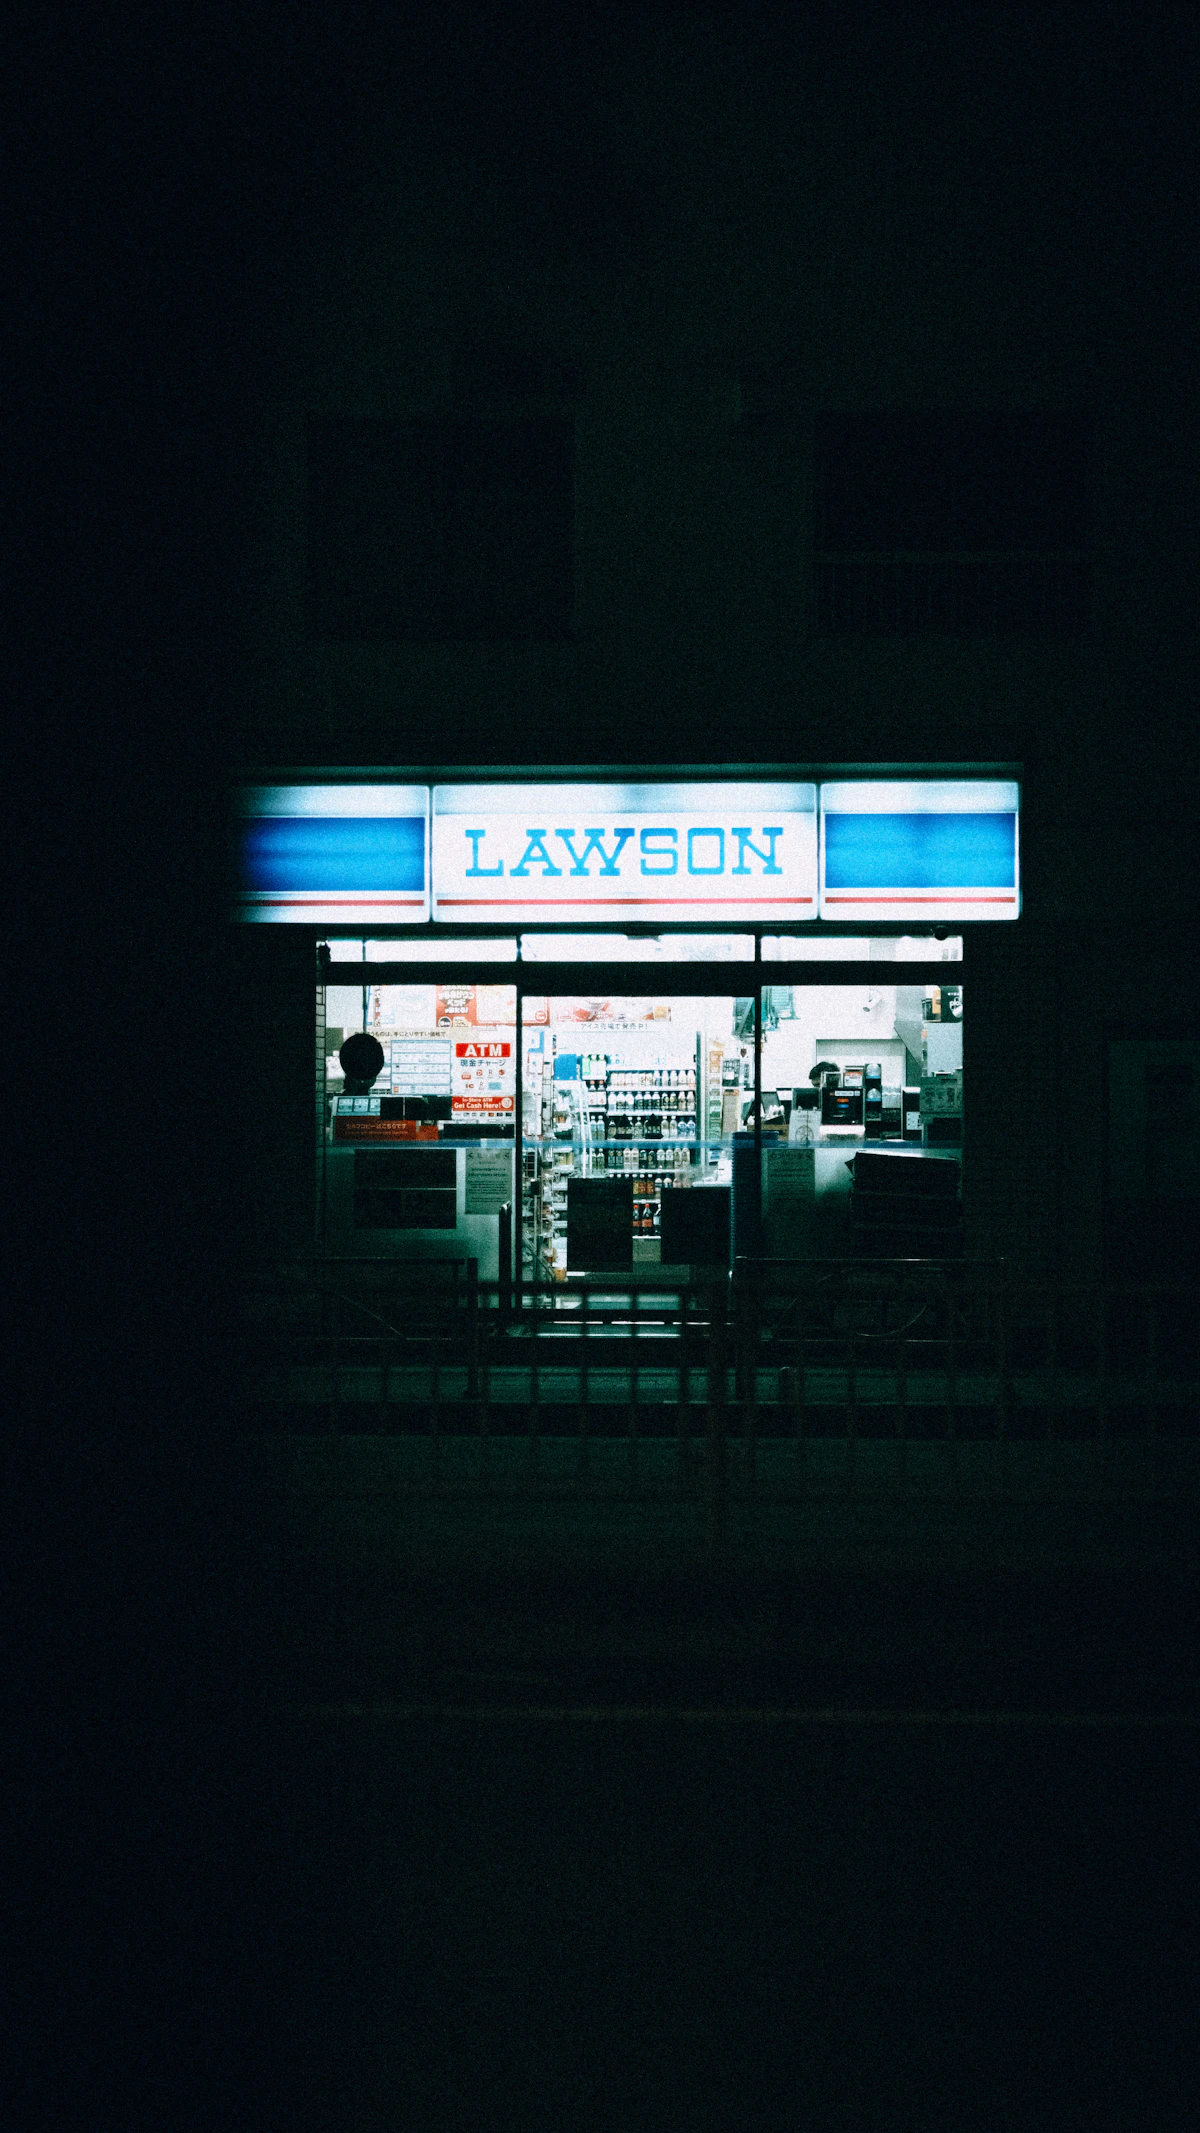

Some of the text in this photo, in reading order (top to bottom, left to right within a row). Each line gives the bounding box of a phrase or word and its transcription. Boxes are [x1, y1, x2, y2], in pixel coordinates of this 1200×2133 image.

[465, 827, 783, 877] LAWSON
[464, 1044, 502, 1056] ATM
[460, 1059, 507, 1067] 現金チャージ
